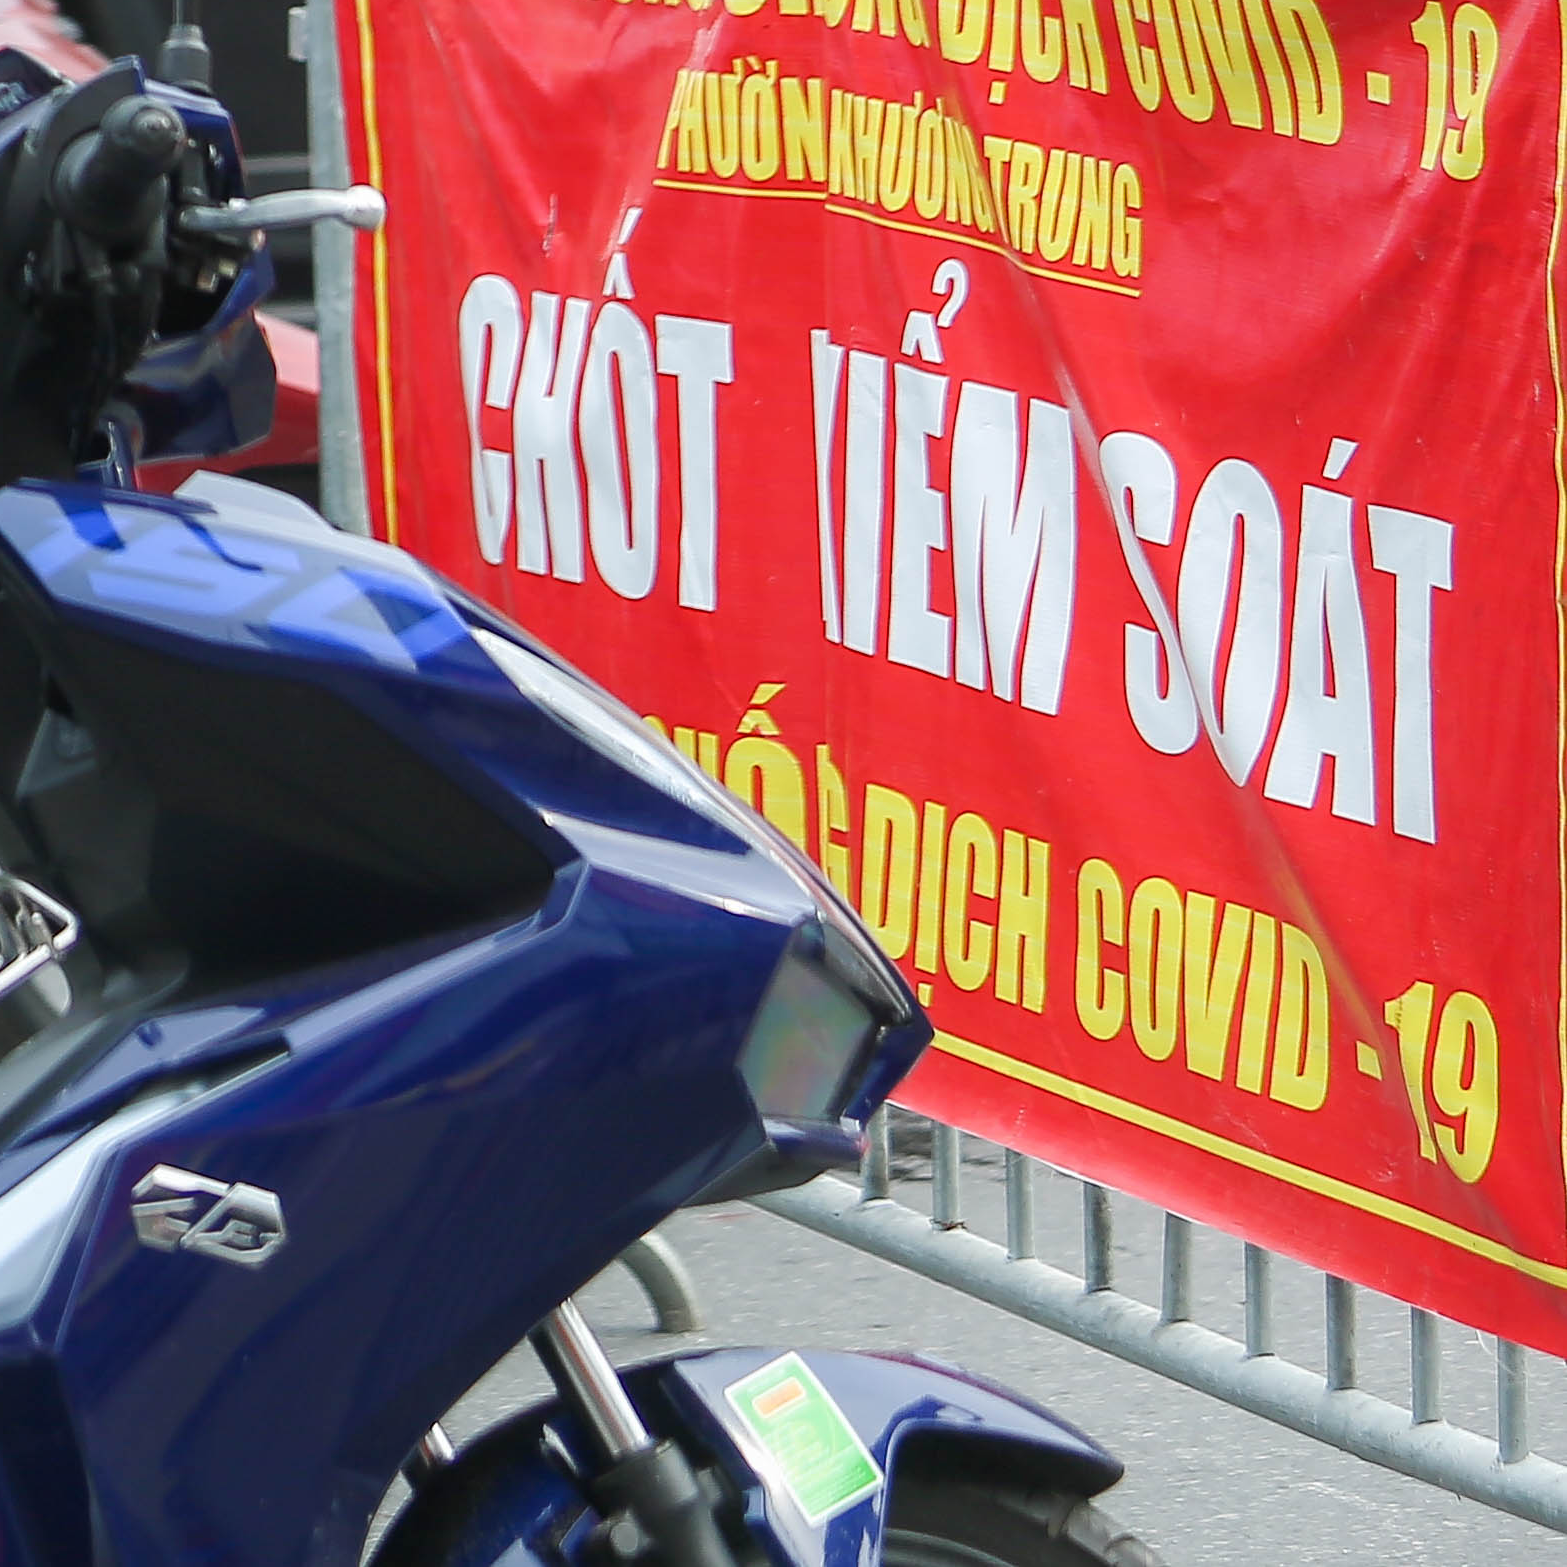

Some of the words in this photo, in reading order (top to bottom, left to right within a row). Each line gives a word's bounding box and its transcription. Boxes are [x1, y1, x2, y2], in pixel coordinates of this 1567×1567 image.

[983, 135, 1141, 279] TRUNG
[1366, 70, 1392, 105] -
[1410, 0, 1498, 181] 19
[458, 207, 734, 612] CHỐT
[1098, 436, 1454, 845] SOÁT
[860, 782, 1051, 1015] DỊCH
[1075, 857, 1330, 1113] COVID
